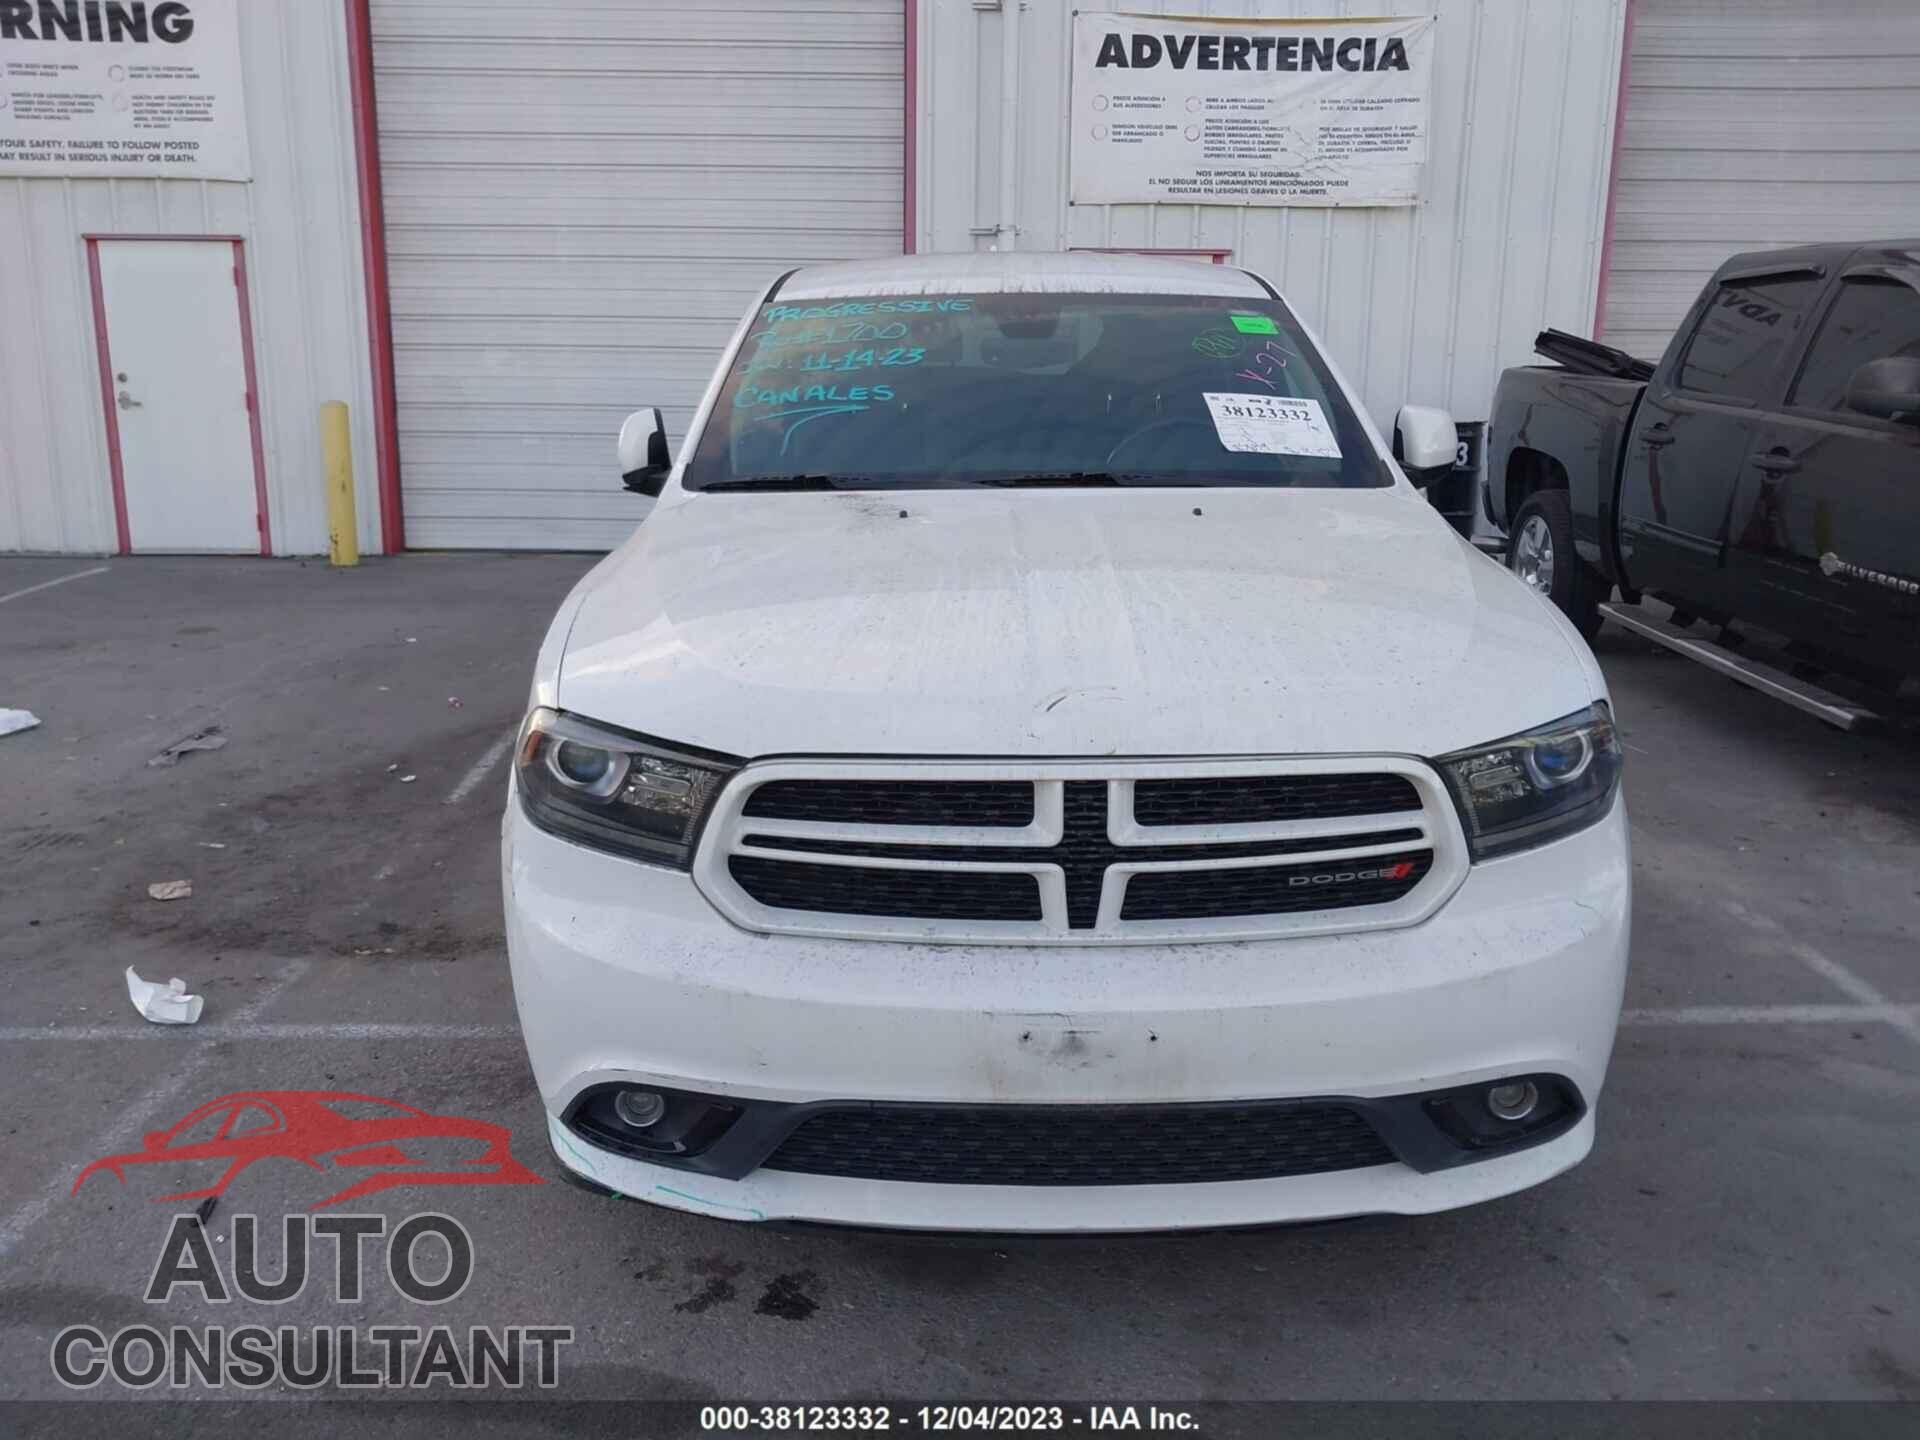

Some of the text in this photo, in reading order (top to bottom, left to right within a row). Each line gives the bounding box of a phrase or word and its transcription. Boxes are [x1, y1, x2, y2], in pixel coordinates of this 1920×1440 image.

[1095, 33, 1411, 72] ADVERTENCIA
[107, 140, 119, 149] TO
[122, 141, 161, 150] FOLLOW
[163, 141, 200, 150] POSTED
[19, 152, 50, 161] RESULT
[54, 153, 65, 161] IN
[68, 153, 108, 162] SERIOUS
[111, 154, 144, 162] INJURY
[147, 154, 161, 162] OR
[766, 299, 976, 322] PROGRESSIVE
[734, 384, 896, 408] CANALES
[1221, 404, 1313, 421] 38123332
[1289, 868, 1397, 887] DODGE
